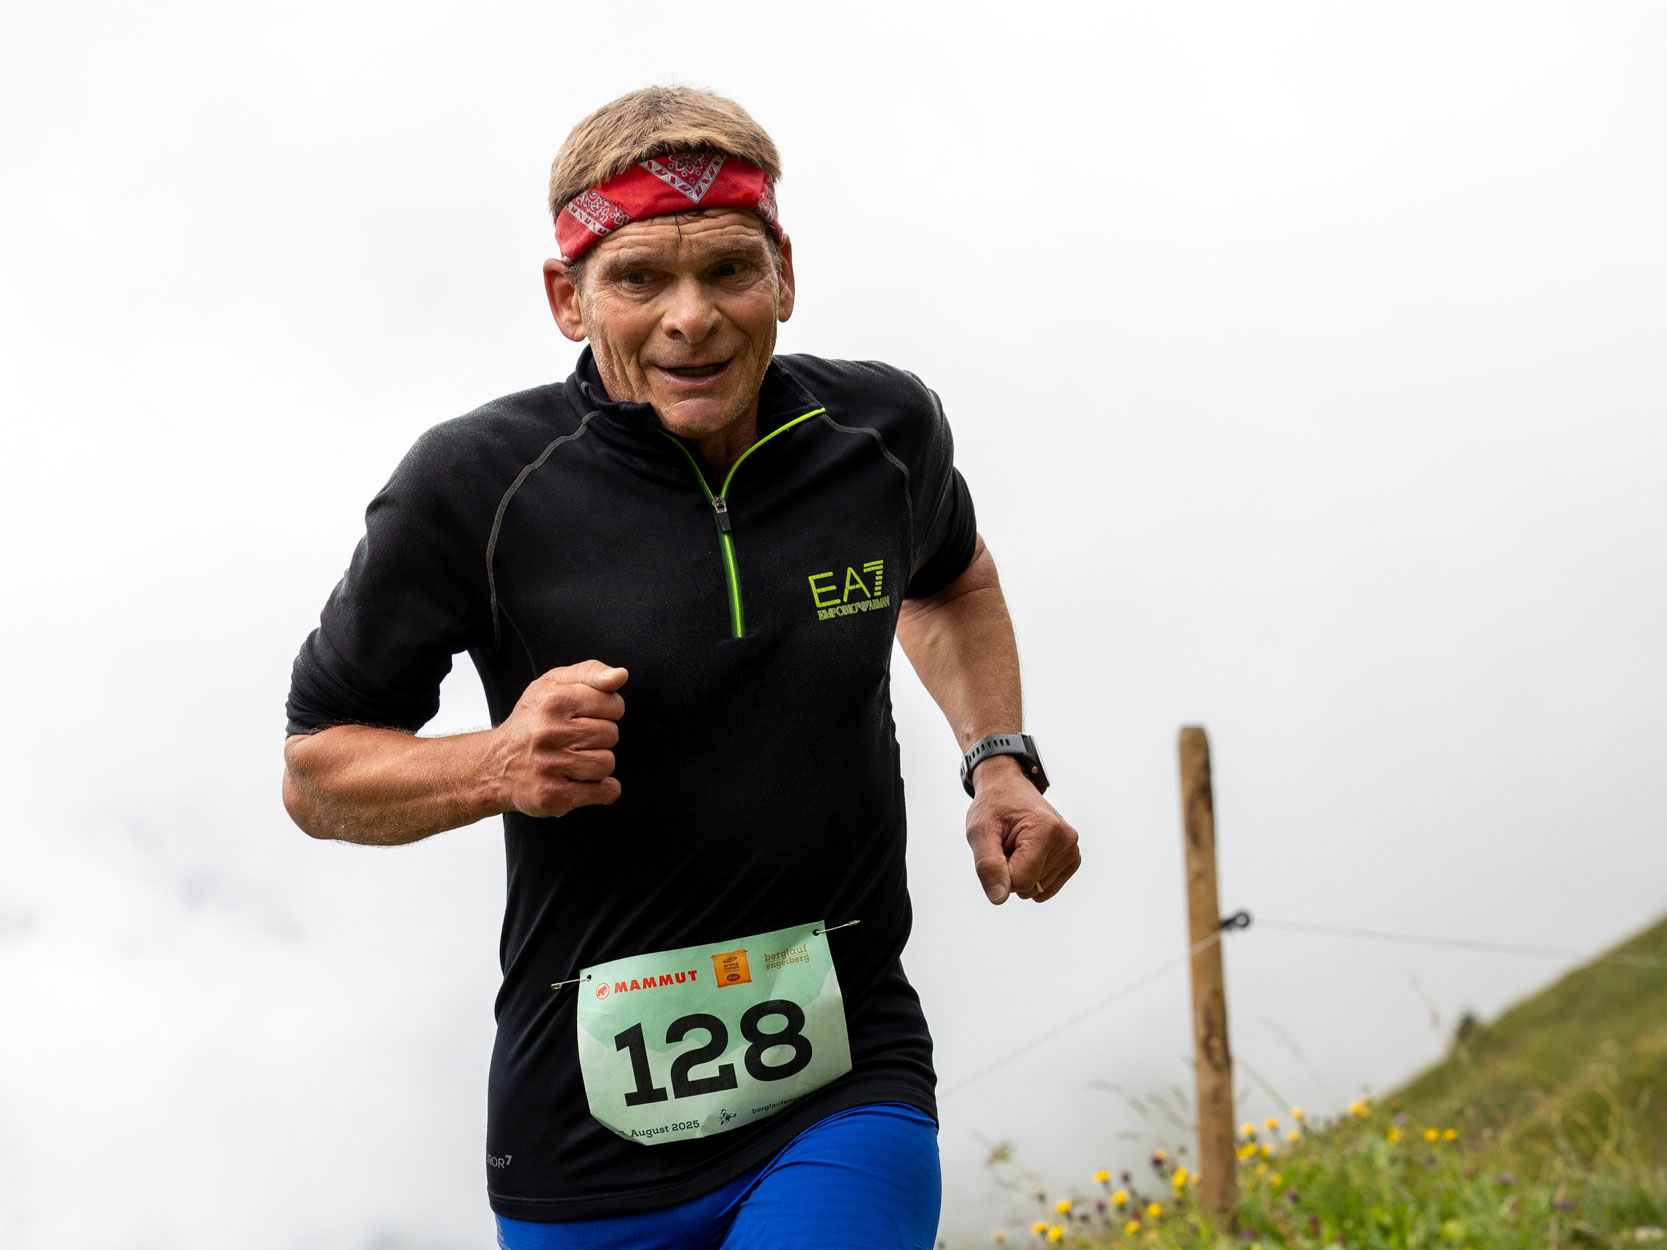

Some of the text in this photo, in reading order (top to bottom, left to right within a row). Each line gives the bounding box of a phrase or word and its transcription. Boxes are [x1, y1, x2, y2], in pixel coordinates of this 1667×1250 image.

[808, 560, 884, 608] EA7
[764, 944, 808, 962] berglauf
[765, 954, 810, 970] engelberg
[614, 969, 698, 994] MAMMUT
[614, 999, 813, 1107] 128
[631, 1125, 670, 1138] August
[671, 1119, 700, 1132] 2025
